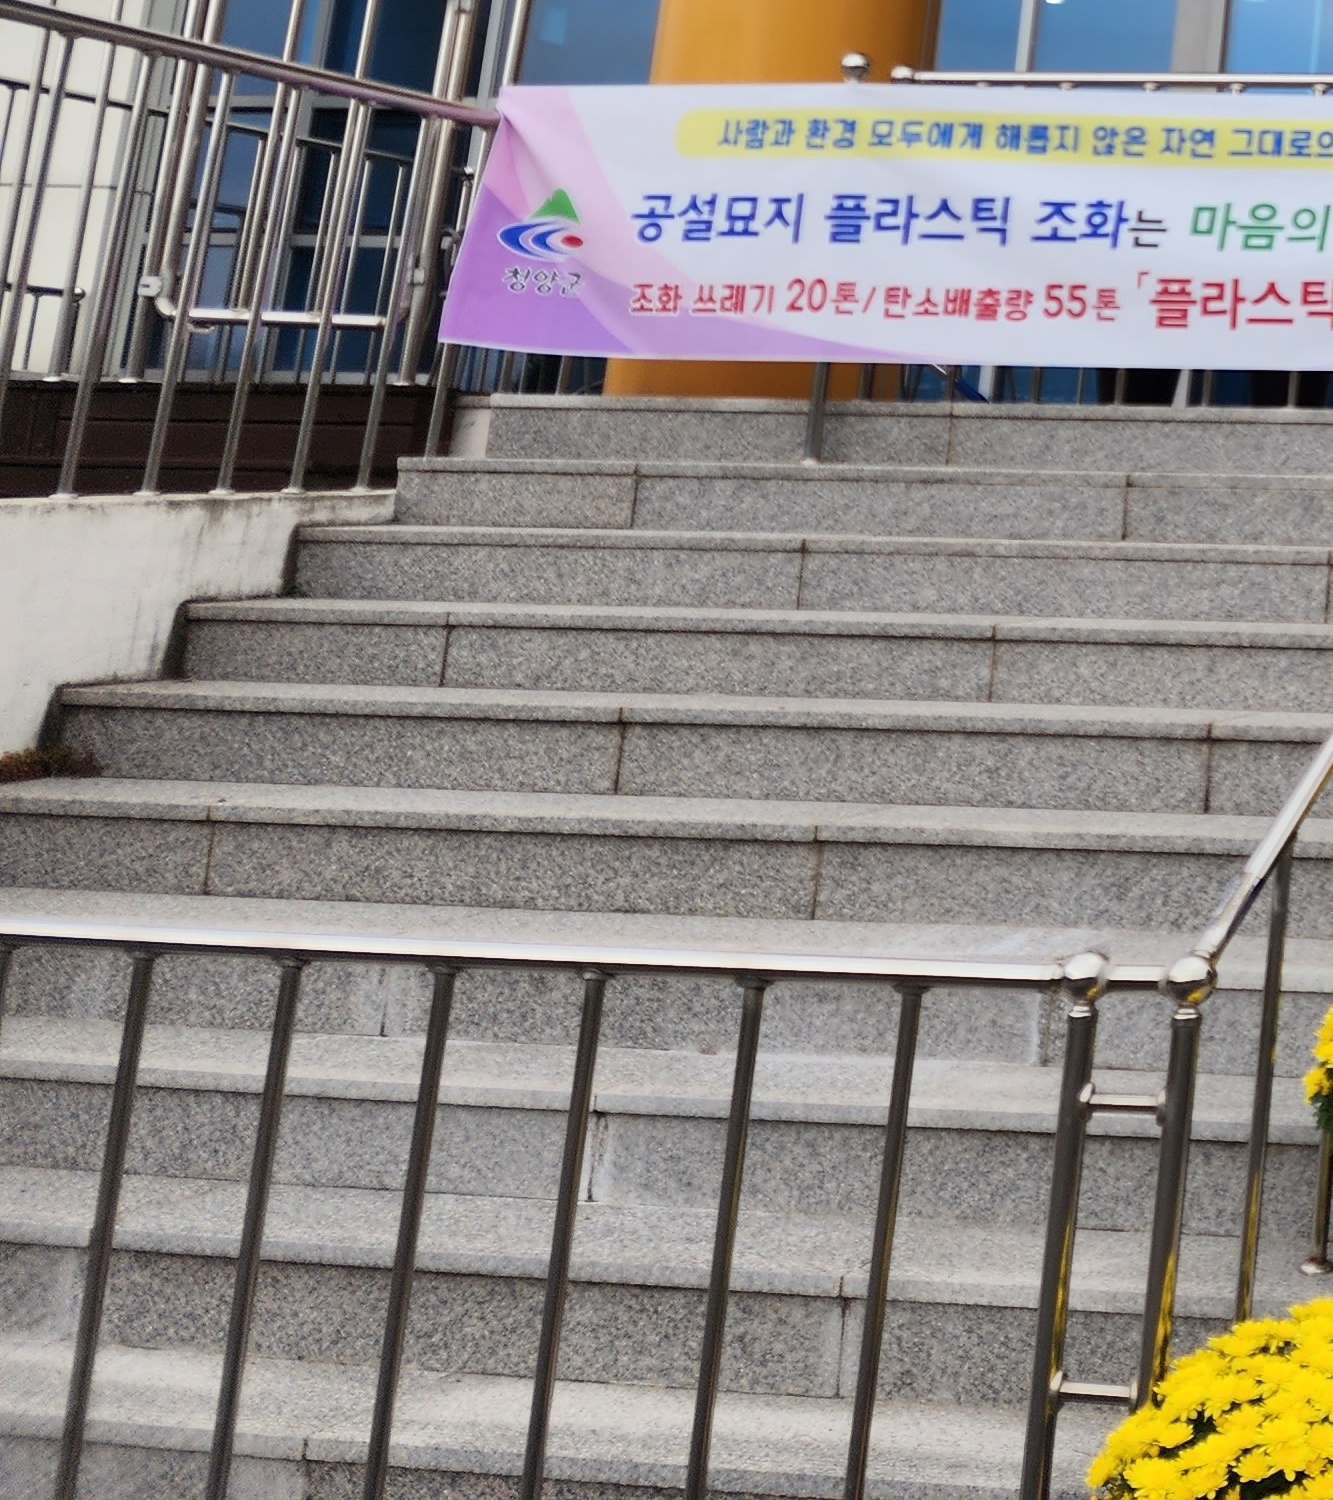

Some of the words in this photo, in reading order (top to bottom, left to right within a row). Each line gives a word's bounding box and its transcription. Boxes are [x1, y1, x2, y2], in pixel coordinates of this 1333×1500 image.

[718, 119, 796, 149] 사람과
[806, 119, 857, 149] 환경
[867, 120, 984, 149] 모두에게
[1092, 126, 1148, 157] 않은
[1160, 127, 1215, 158] 자연
[631, 193, 804, 245] 공설묘지
[824, 194, 1011, 247] 플라스틱
[1030, 200, 1168, 249] 조화는
[1191, 202, 1332, 252] 마음의
[504, 267, 582, 296] 청양군
[630, 283, 683, 313] 조화
[691, 283, 774, 315] 쓰레기
